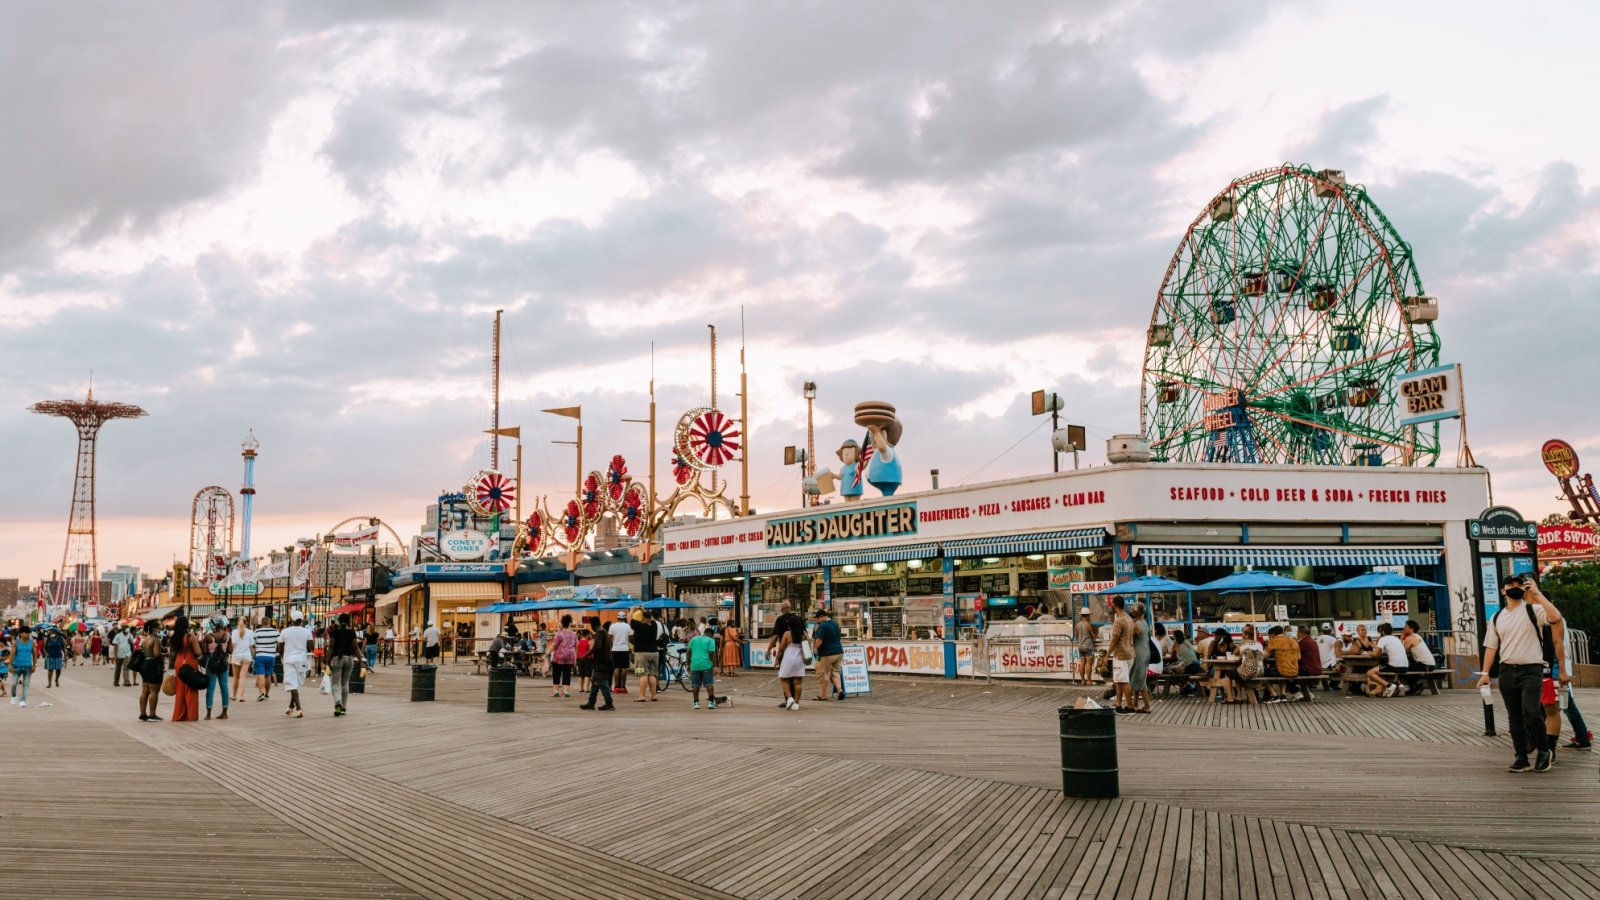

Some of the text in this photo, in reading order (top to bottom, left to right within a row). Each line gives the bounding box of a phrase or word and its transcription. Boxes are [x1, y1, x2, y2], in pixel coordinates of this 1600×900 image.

[1401, 375, 1446, 397] CLAM
[1203, 387, 1239, 413] WONDER
[1407, 394, 1444, 413] BAR
[1203, 411, 1236, 432] WHEEL
[1170, 487, 1447, 503] SEAFOOD COLD BEER & SODA FRENCH FRIES
[920, 490, 1105, 522] FRANKFURTERS PIZZA SAUSAGES CLAM BAR
[765, 506, 915, 546] PAUL'S DAUGHTER
[1481, 525, 1527, 535] West 10th Street
[680, 541, 689, 550] COLD
[690, 539, 700, 549] BEER
[748, 531, 763, 541] CREAM
[1071, 583, 1095, 592] CLAM
[1377, 601, 1406, 613] BEER
[866, 645, 909, 668] PIZZA
[1002, 653, 1064, 668] SAUSAGE
